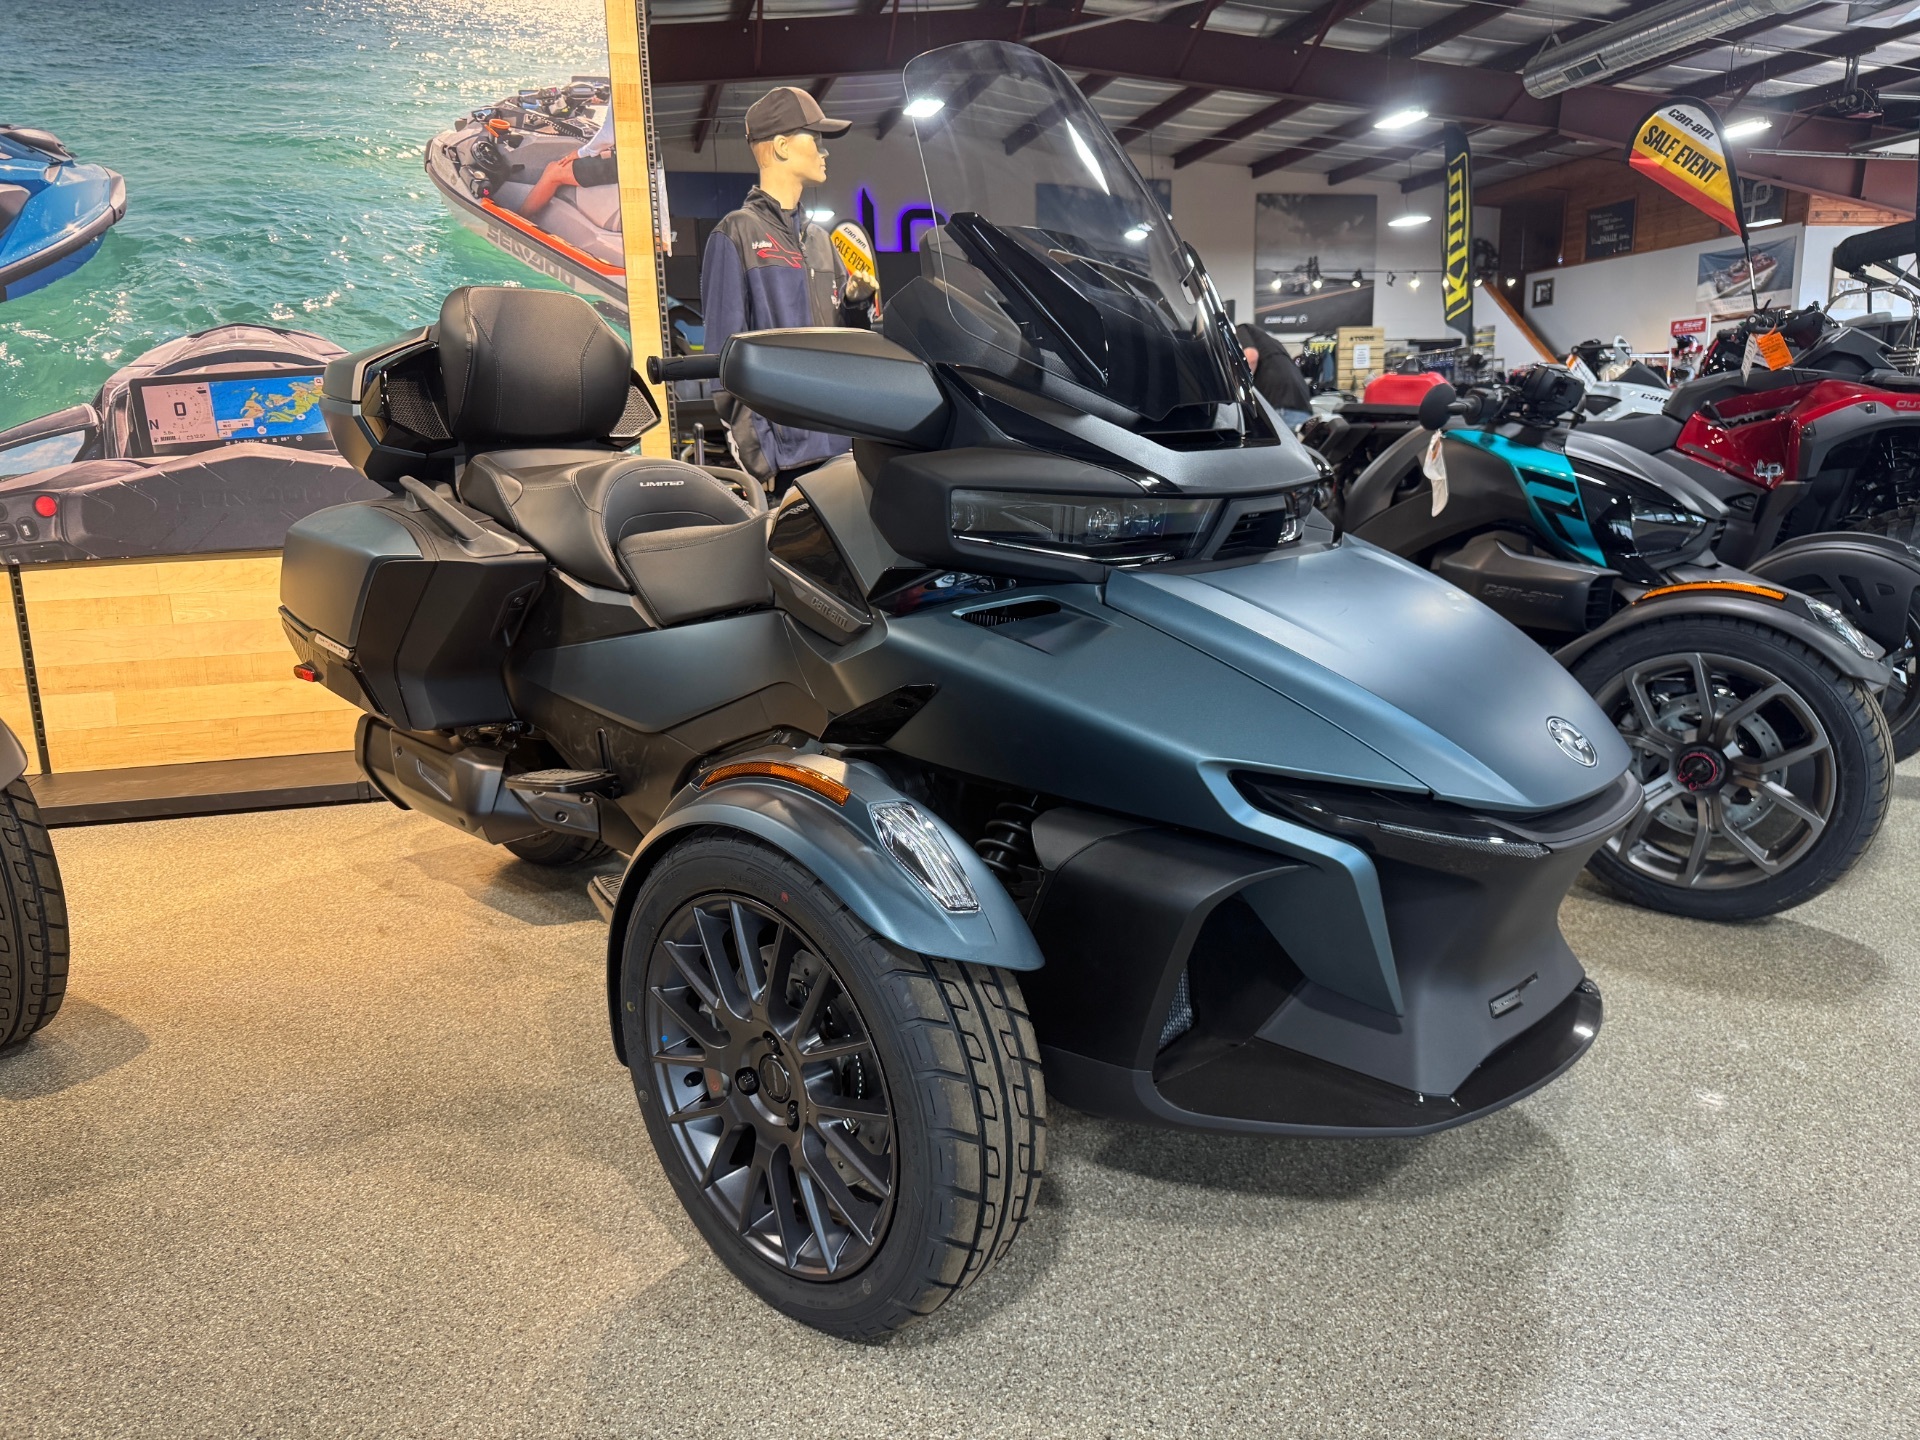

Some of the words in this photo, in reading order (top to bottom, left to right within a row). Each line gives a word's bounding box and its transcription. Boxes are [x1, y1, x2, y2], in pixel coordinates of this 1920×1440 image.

[1668, 108, 1714, 141] can-am
[1642, 125, 1681, 159] SALE
[1672, 144, 1722, 184] EVENT
[843, 226, 867, 249] can-am
[833, 236, 852, 258] SALE
[847, 252, 871, 274] EVENT
[149, 419, 160, 430] N
